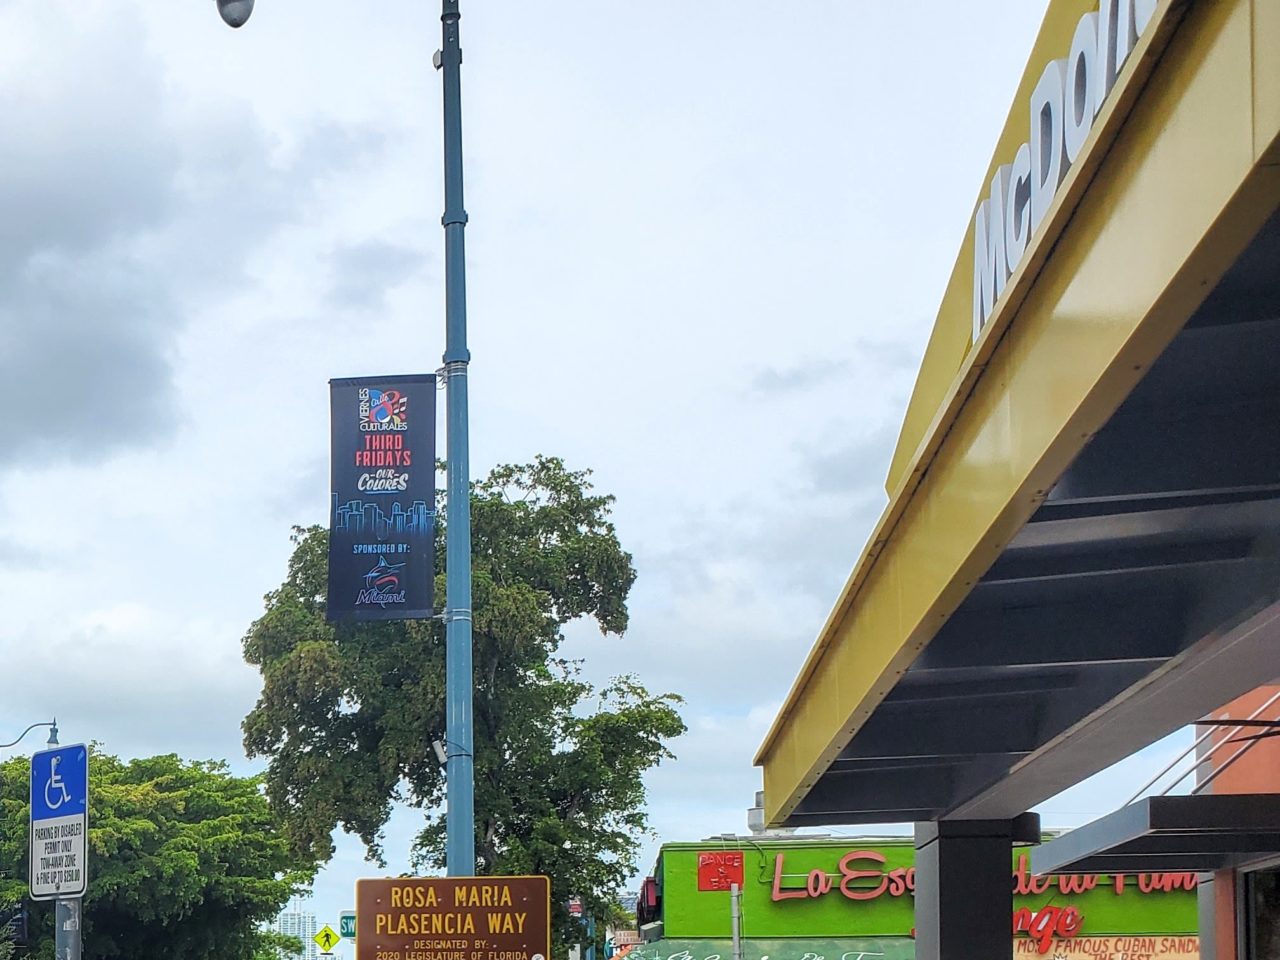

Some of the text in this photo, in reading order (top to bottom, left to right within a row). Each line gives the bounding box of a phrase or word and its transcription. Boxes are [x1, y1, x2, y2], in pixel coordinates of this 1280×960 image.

[972, 0, 1158, 345] McDon
[359, 388, 369, 424] VIERNES
[360, 422, 408, 431] CULTURALES
[365, 435, 403, 450] THIRD
[356, 451, 412, 466] FRIDAYS
[353, 543, 411, 554] SPONSORED BY:
[355, 589, 406, 605] Miami
[35, 823, 82, 841] PARKING BY DISABLED
[45, 839, 72, 855] PERMIT ONLY
[40, 854, 76, 870] TOW-AWAY ZONE
[700, 855, 741, 866] DANCE
[40, 872, 50, 885] FINE
[51, 871, 57, 884] UP
[57, 870, 63, 883] TO
[710, 877, 733, 889] EAT
[772, 852, 832, 902] La
[391, 885, 512, 908] ROSA MARIA
[340, 919, 356, 933] SW
[376, 912, 527, 935] PLASENCIA WAY
[414, 940, 489, 950] DESIGNATED BY:
[1055, 938, 1110, 954] FAMOUS
[1114, 937, 1156, 953] CUBAN
[376, 952, 528, 960] 2020 LEGISLATURE OF FLORIDA
